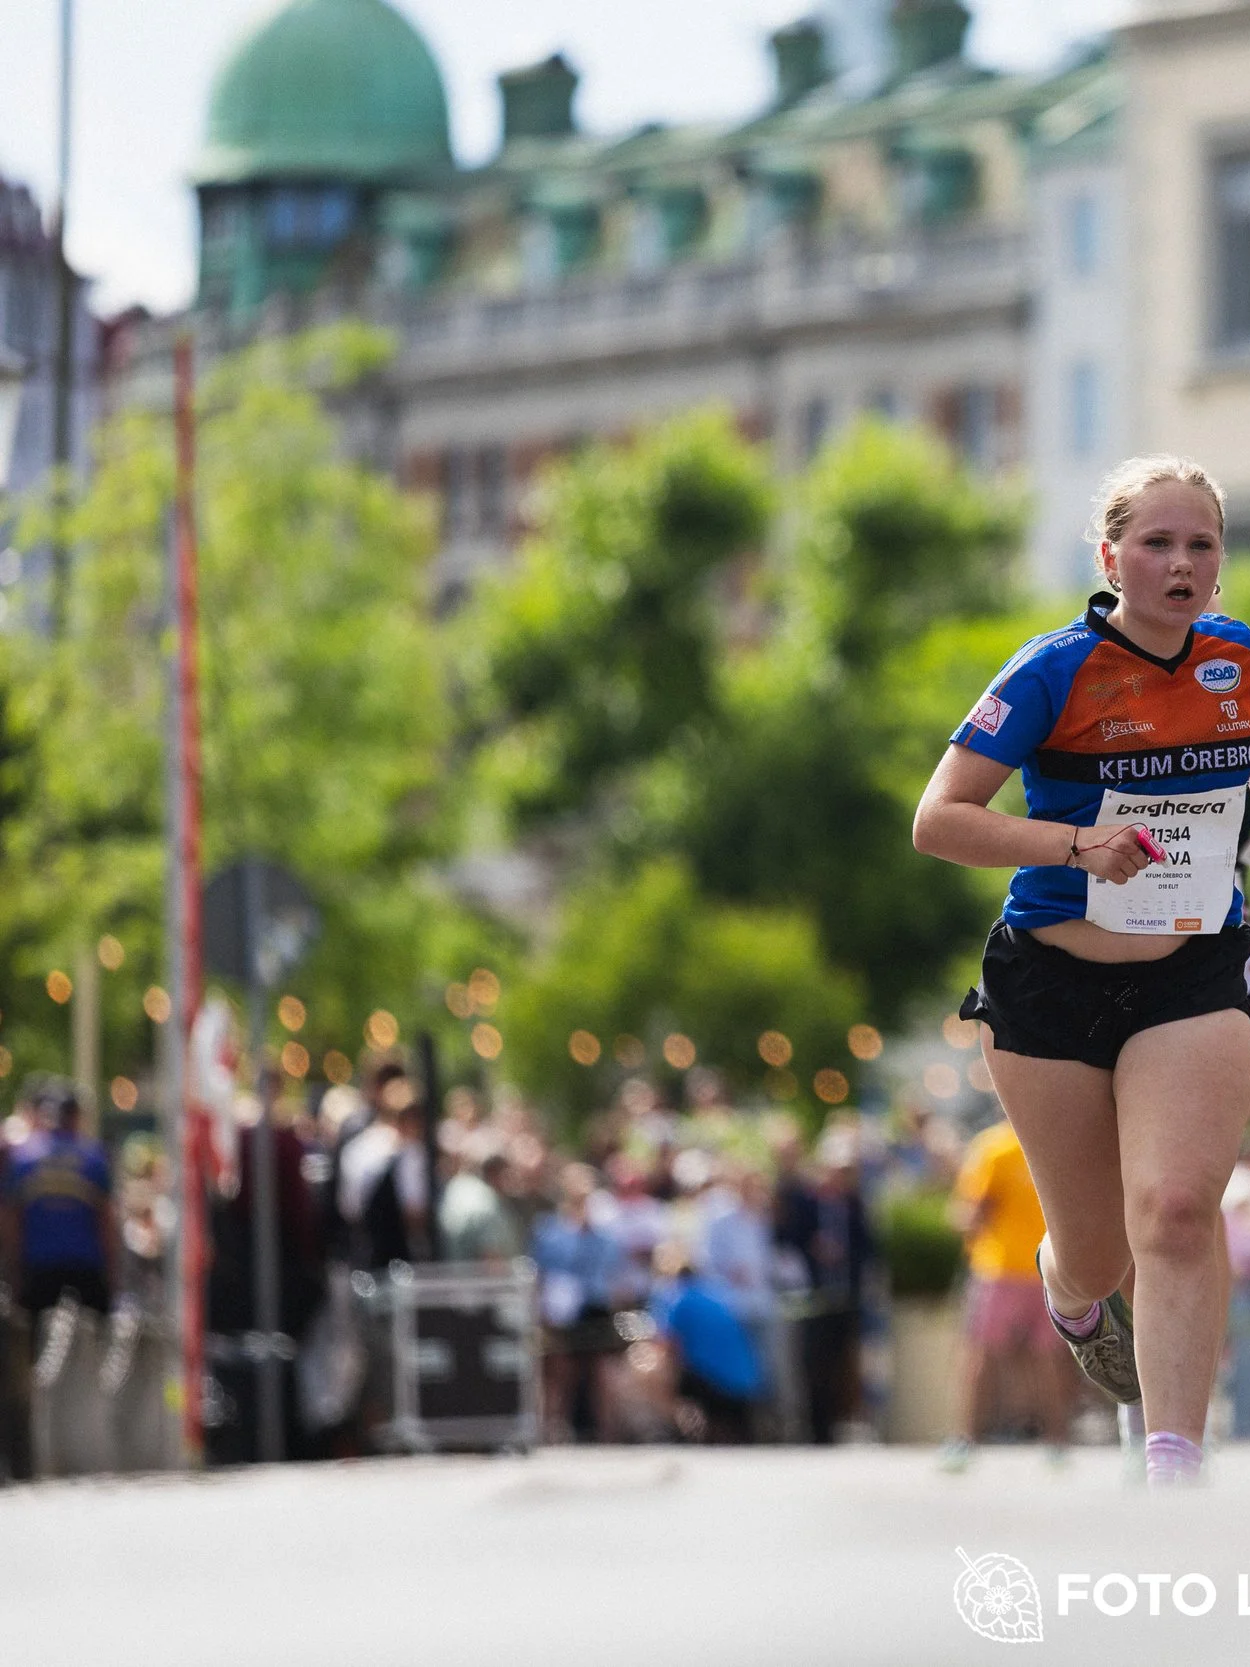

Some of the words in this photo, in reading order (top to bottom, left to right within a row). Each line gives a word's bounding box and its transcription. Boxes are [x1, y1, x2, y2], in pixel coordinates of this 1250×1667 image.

[1053, 632, 1090, 649] TRIMTEX
[1202, 665, 1237, 682] MOAB
[1100, 718, 1156, 741] Beatum
[1216, 719, 1250, 733] ULLMAX
[1099, 754, 1172, 780] KFUM
[1116, 800, 1225, 817] bagheera
[1149, 826, 1191, 843] 11344
[1162, 871, 1183, 879] ÖREBRO
[1126, 918, 1167, 927] CHALMERS
